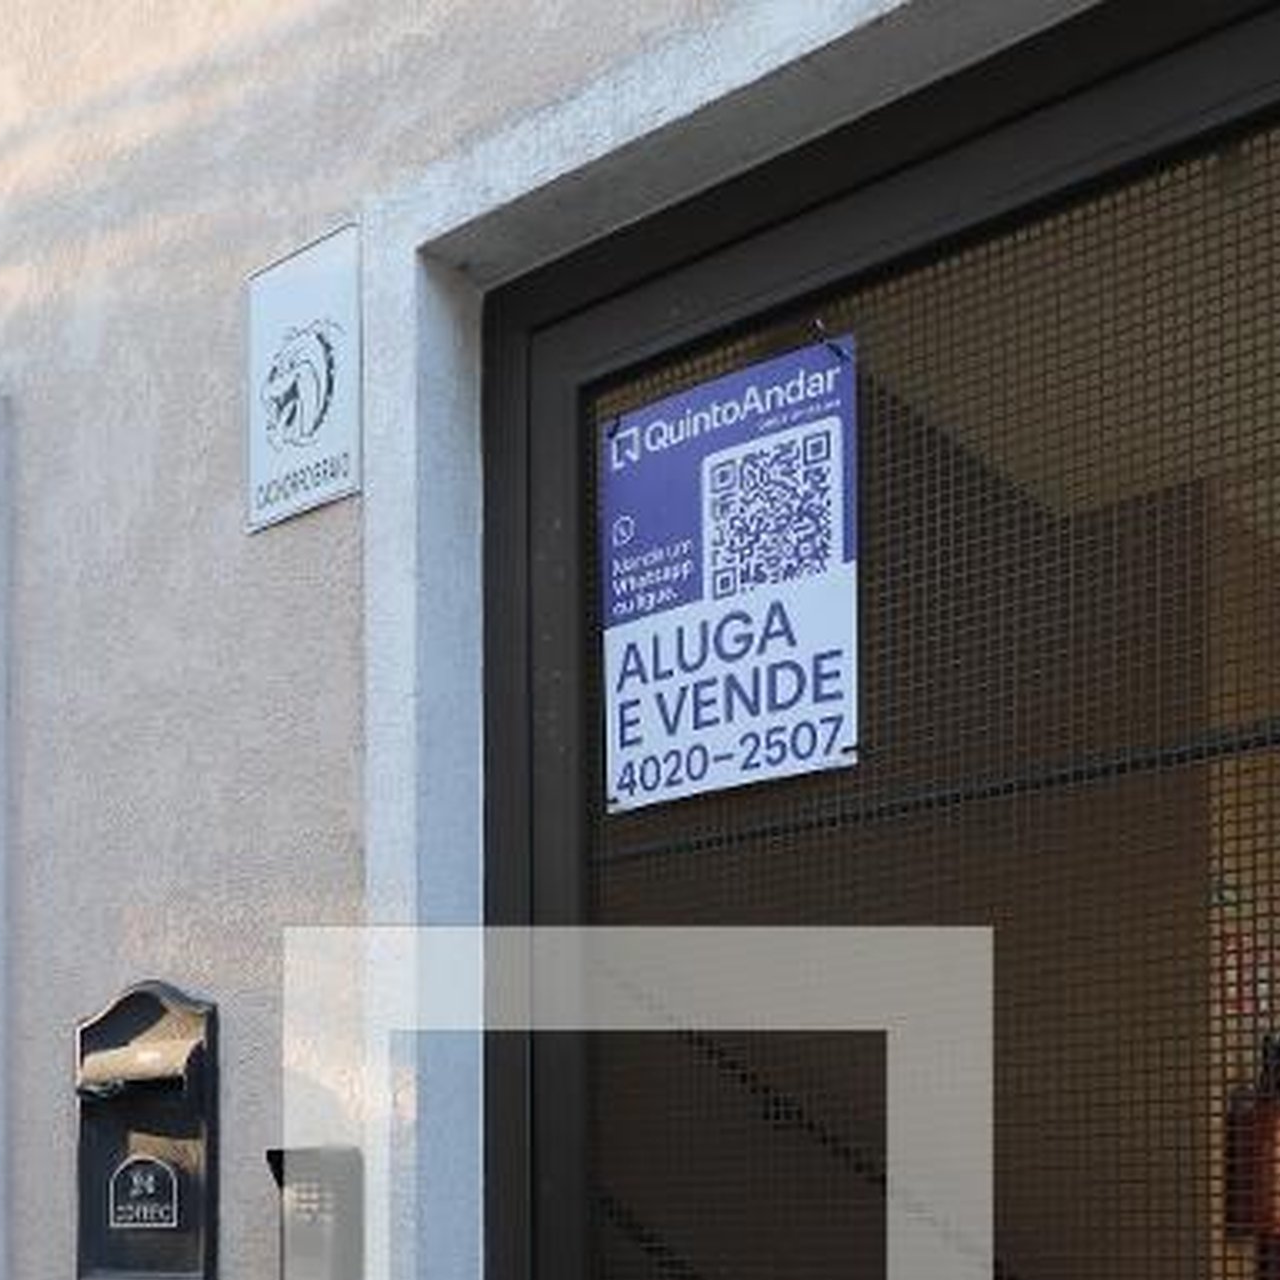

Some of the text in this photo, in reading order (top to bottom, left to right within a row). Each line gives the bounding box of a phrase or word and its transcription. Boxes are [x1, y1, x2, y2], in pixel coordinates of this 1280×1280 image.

[644, 366, 841, 451] QuintoAndar
[616, 600, 797, 693] ALUGA
[619, 649, 844, 750] E VENDE
[616, 714, 844, 796] 4020-2507
